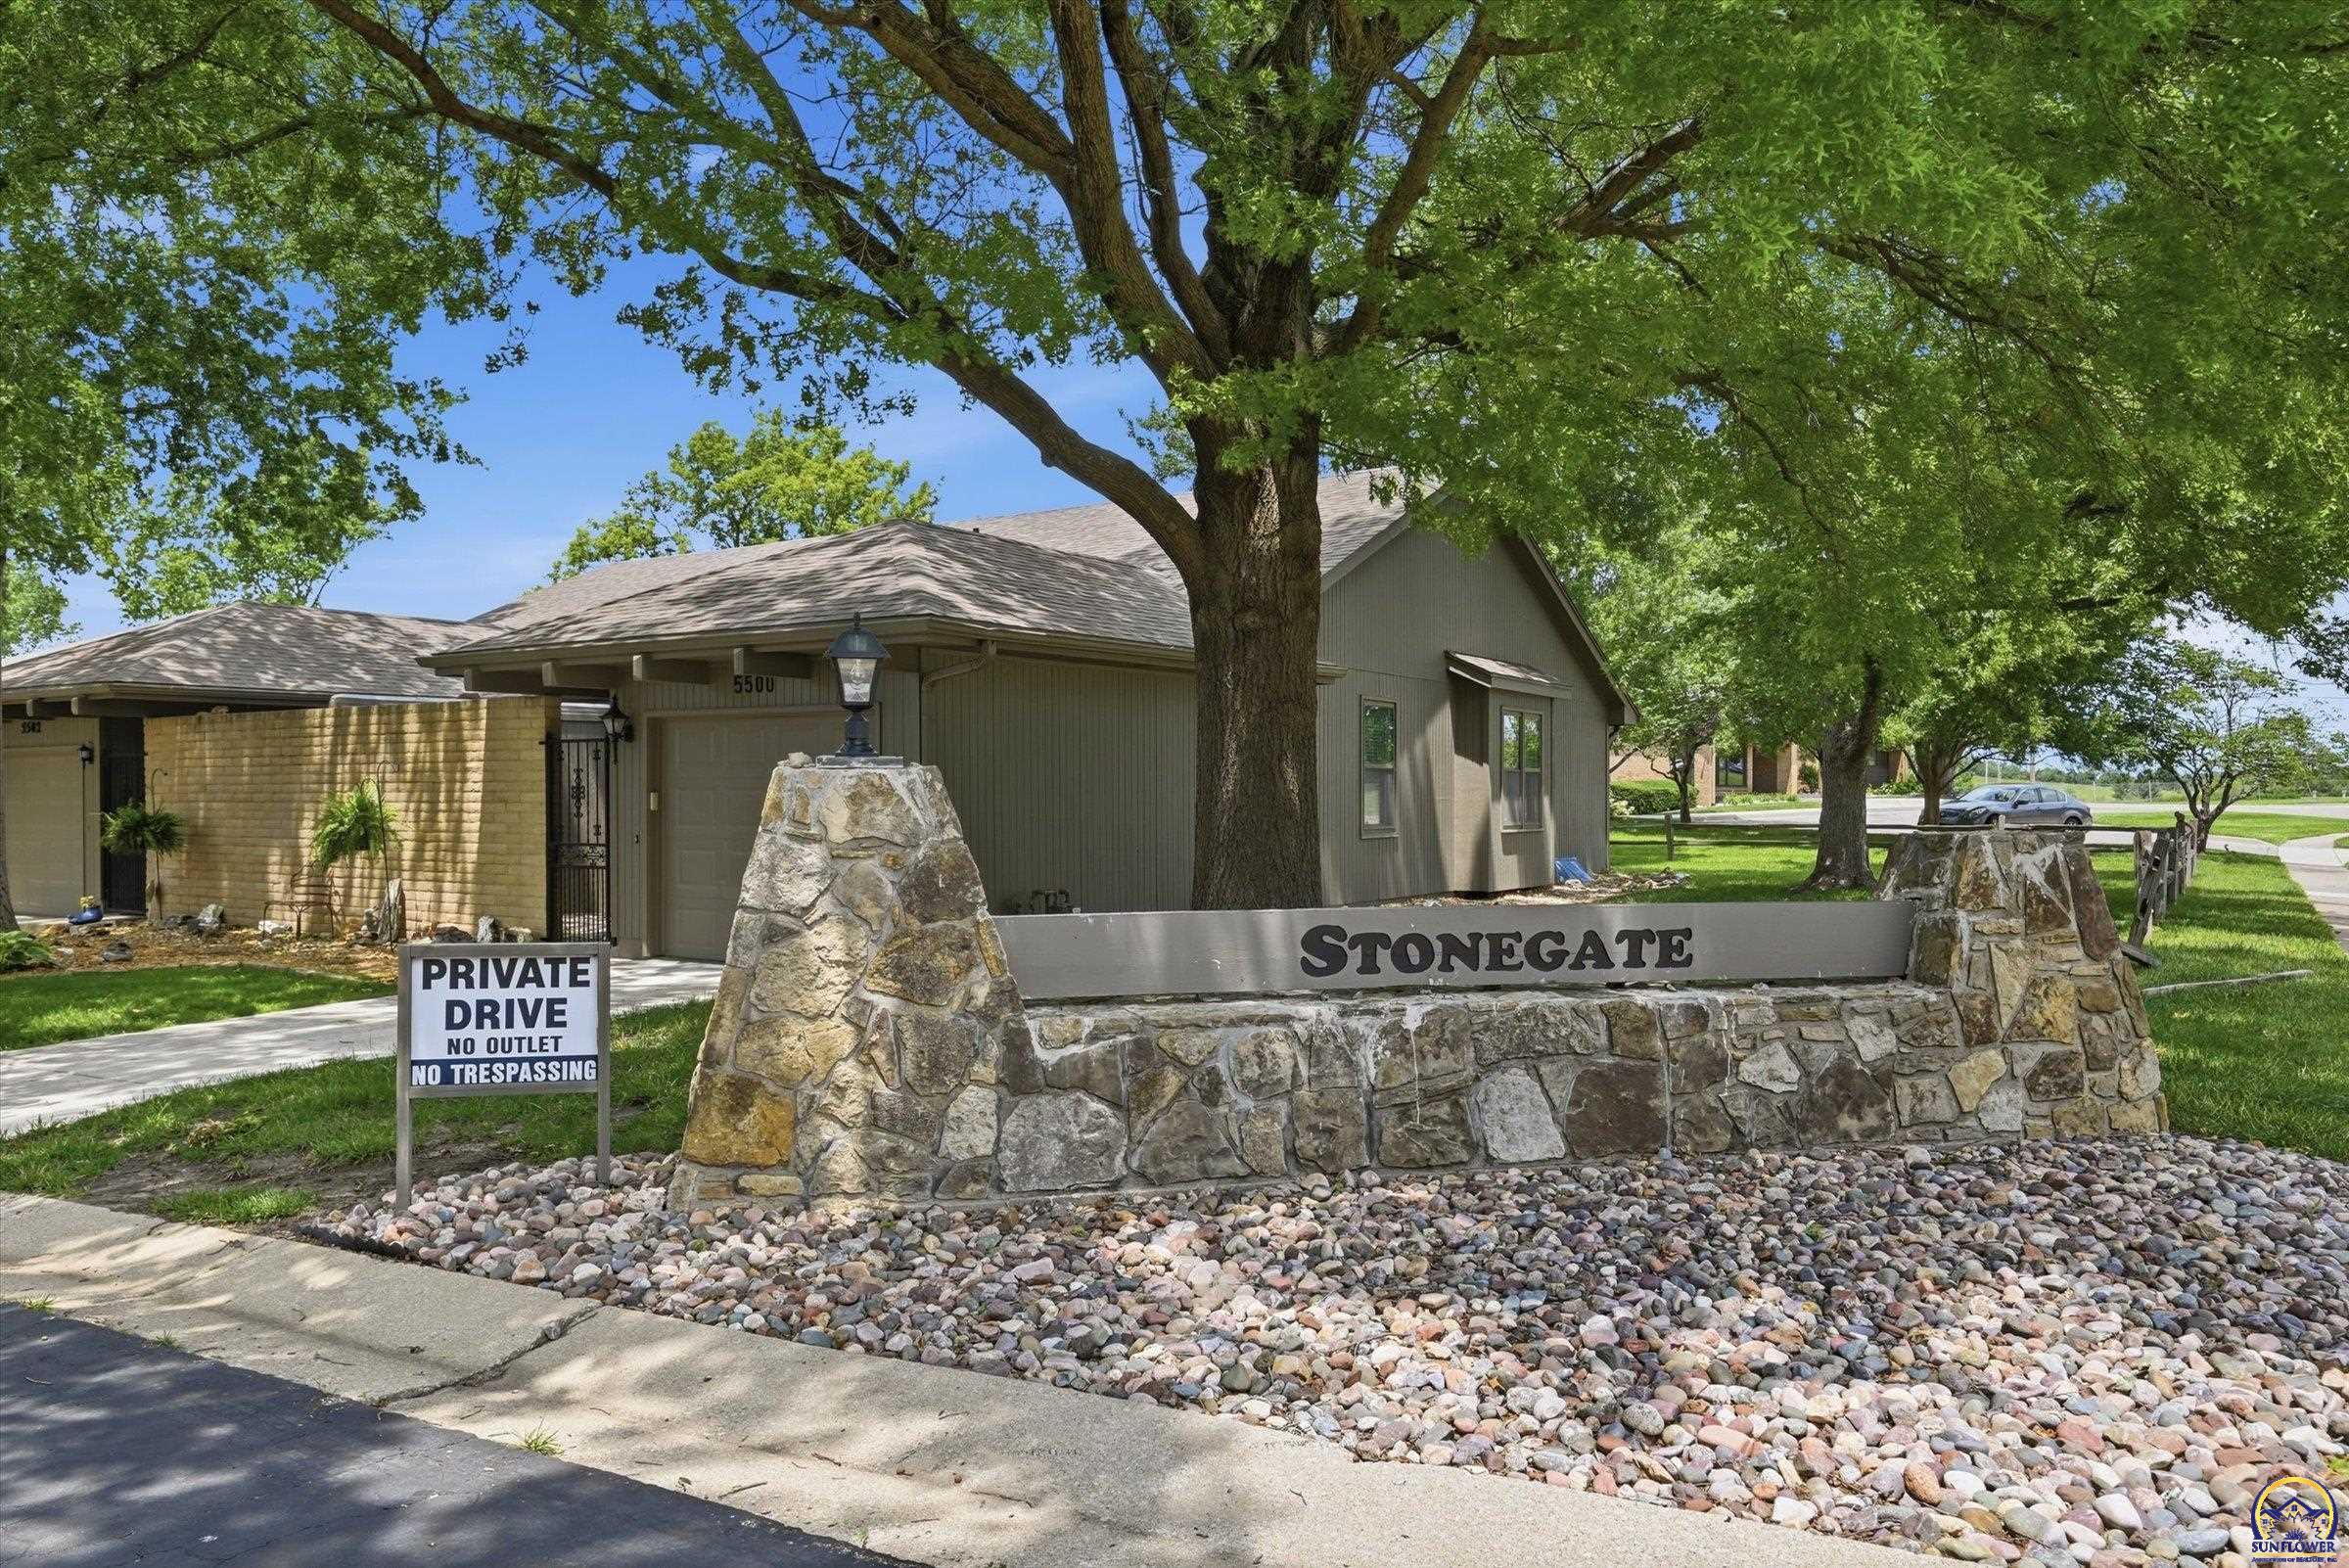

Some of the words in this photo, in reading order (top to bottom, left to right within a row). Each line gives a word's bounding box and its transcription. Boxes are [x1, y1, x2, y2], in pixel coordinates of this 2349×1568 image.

[1300, 924, 1694, 977] STONEGATE
[422, 956, 591, 991] PRIVATE
[444, 997, 568, 1031] DRIVE
[446, 1037, 477, 1056] NO
[485, 1036, 564, 1054] OUTLET
[411, 1063, 441, 1086] NO
[450, 1060, 597, 1085] TRESPASSING
